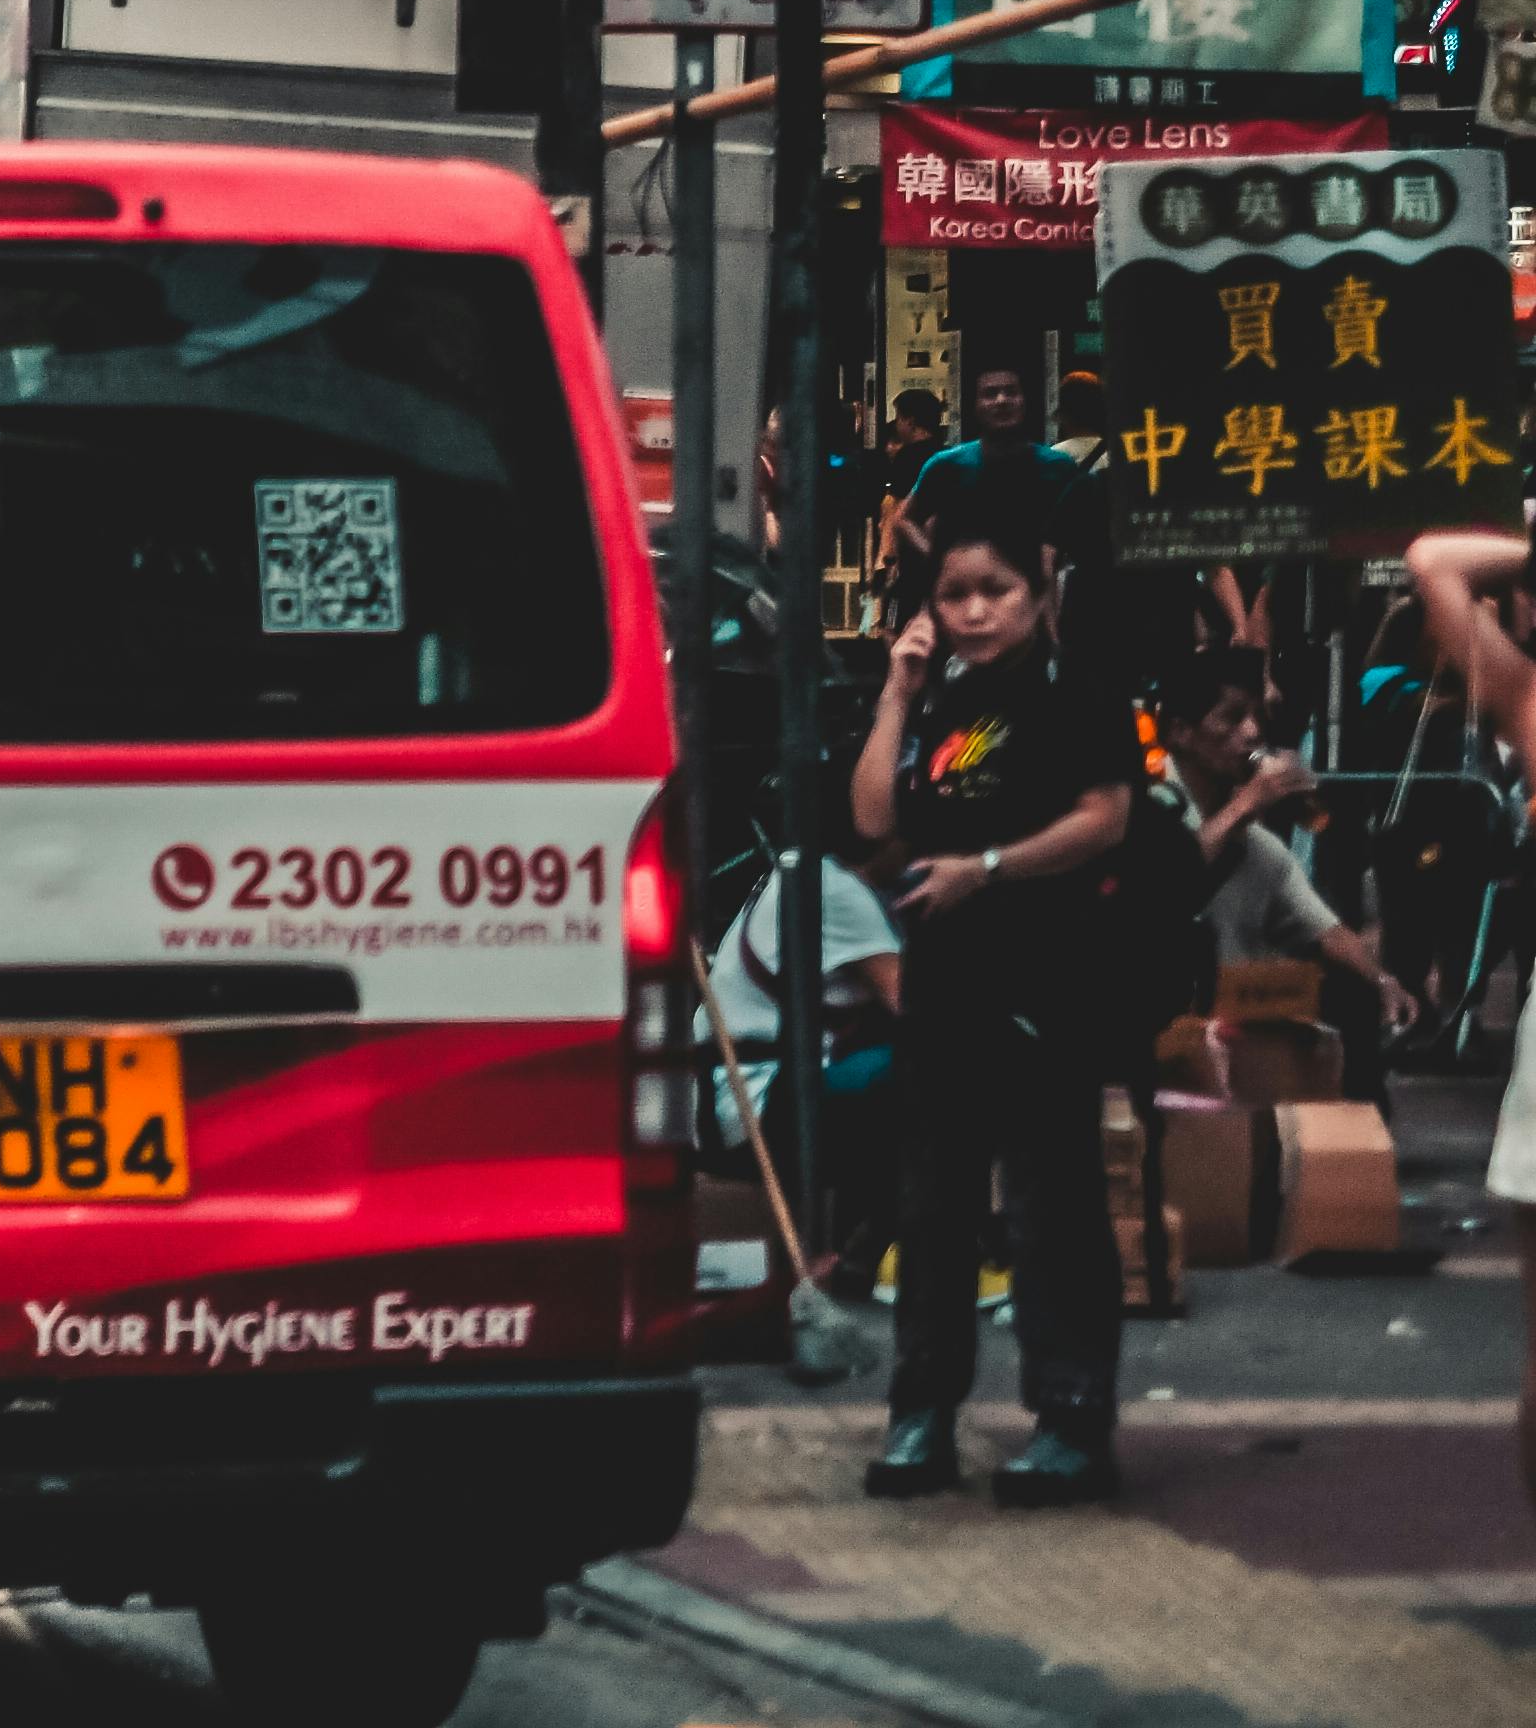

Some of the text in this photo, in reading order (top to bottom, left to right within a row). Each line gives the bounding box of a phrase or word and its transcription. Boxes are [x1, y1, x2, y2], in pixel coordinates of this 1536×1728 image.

[1039, 118, 1230, 151] Love Lens
[929, 216, 1007, 241] Korea
[1218, 276, 1387, 371] 買賣
[1120, 397, 1514, 498] 中學課本
[228, 842, 607, 911] 2302 0991
